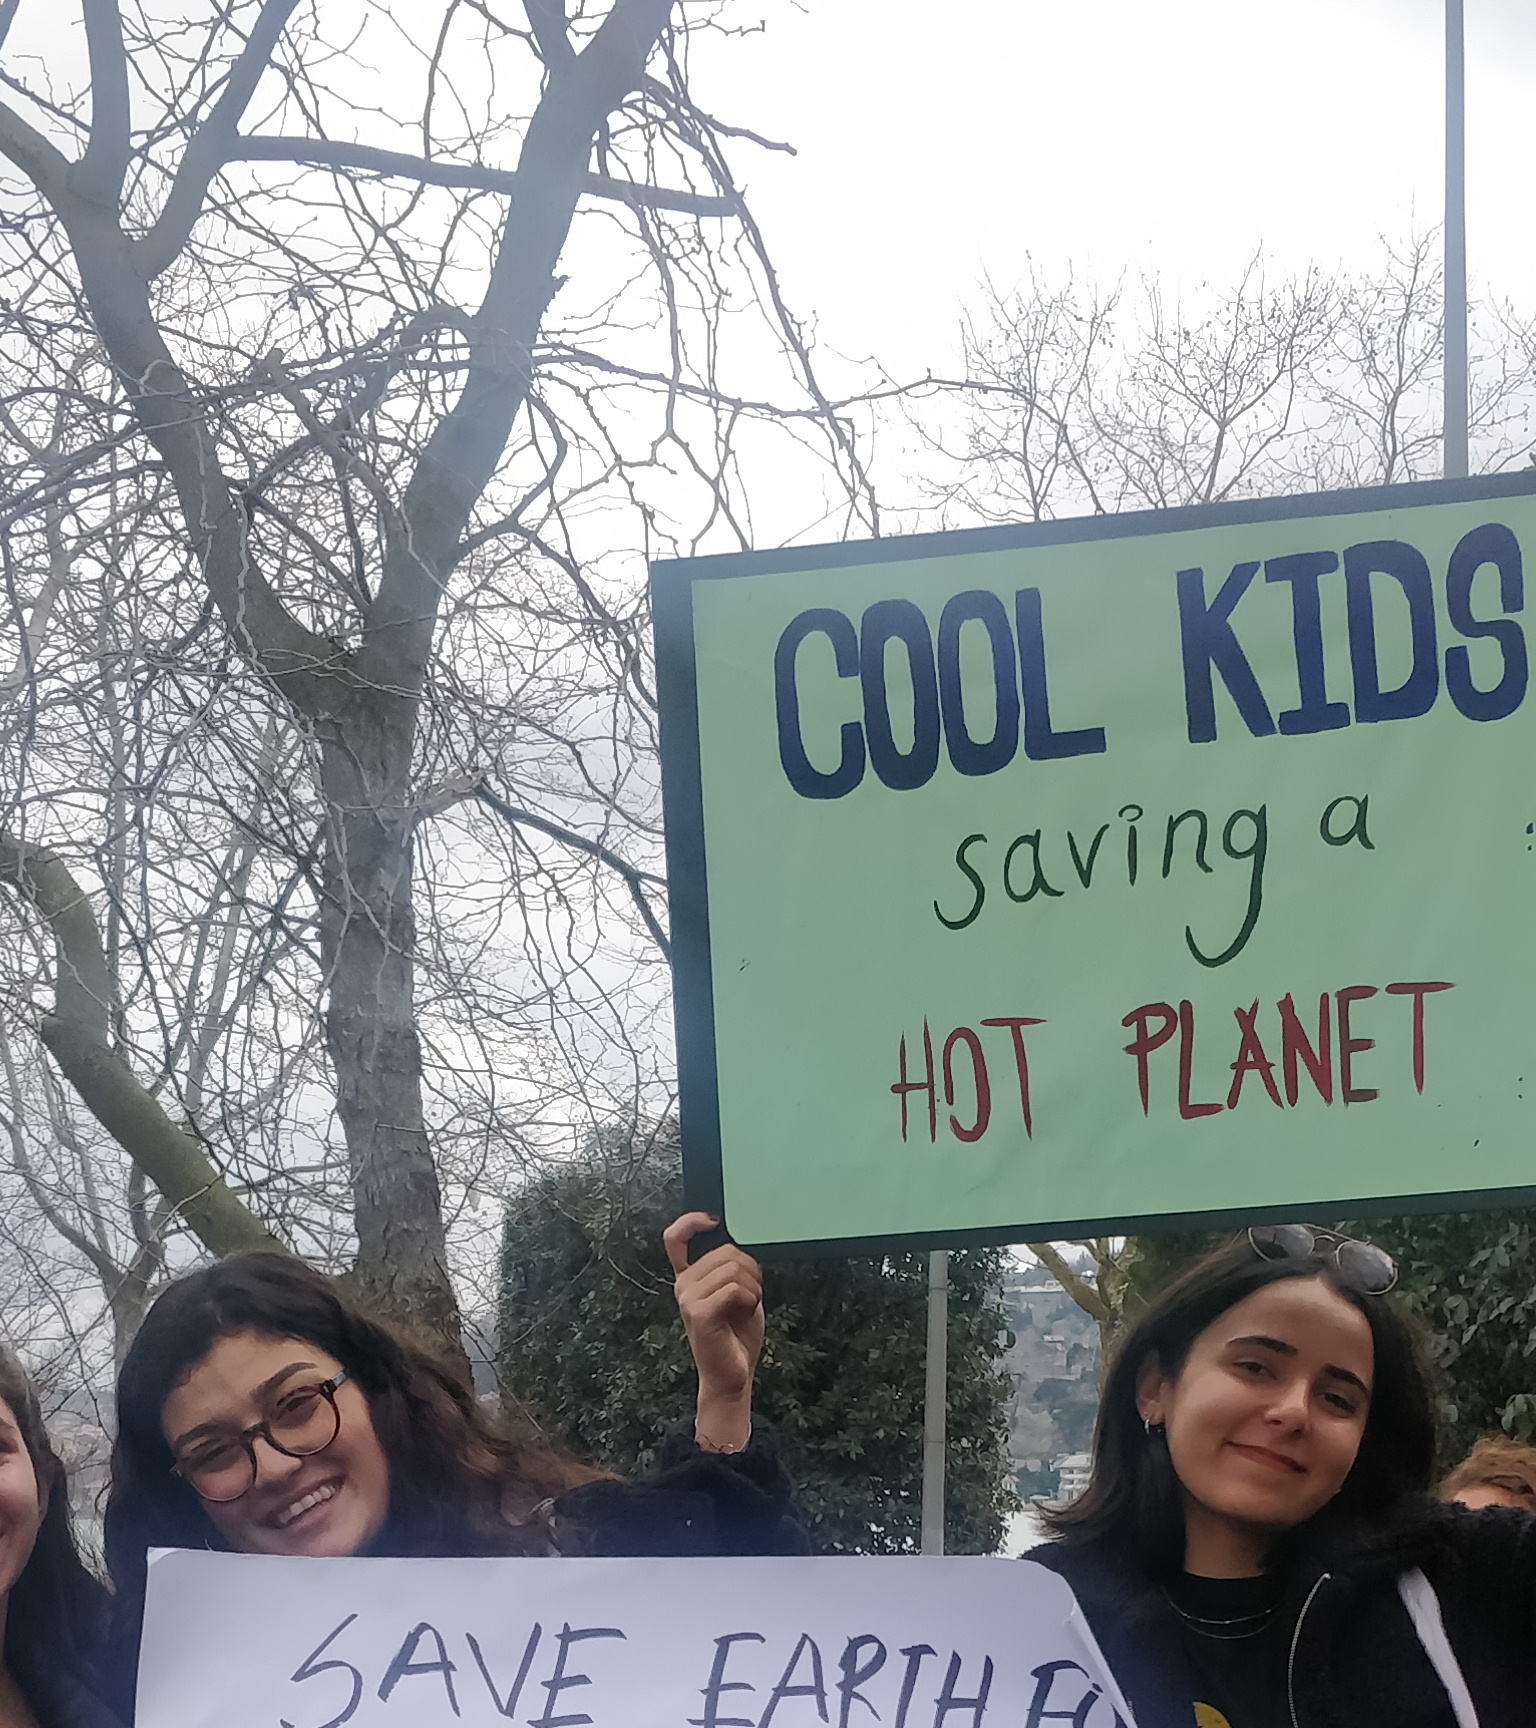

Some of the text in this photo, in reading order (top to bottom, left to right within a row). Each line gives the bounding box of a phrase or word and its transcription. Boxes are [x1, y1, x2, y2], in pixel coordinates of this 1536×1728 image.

[774, 523, 1529, 799] COOL KIDS
[934, 792, 1376, 968] saving a
[891, 980, 1456, 1142] HOT PLANET
